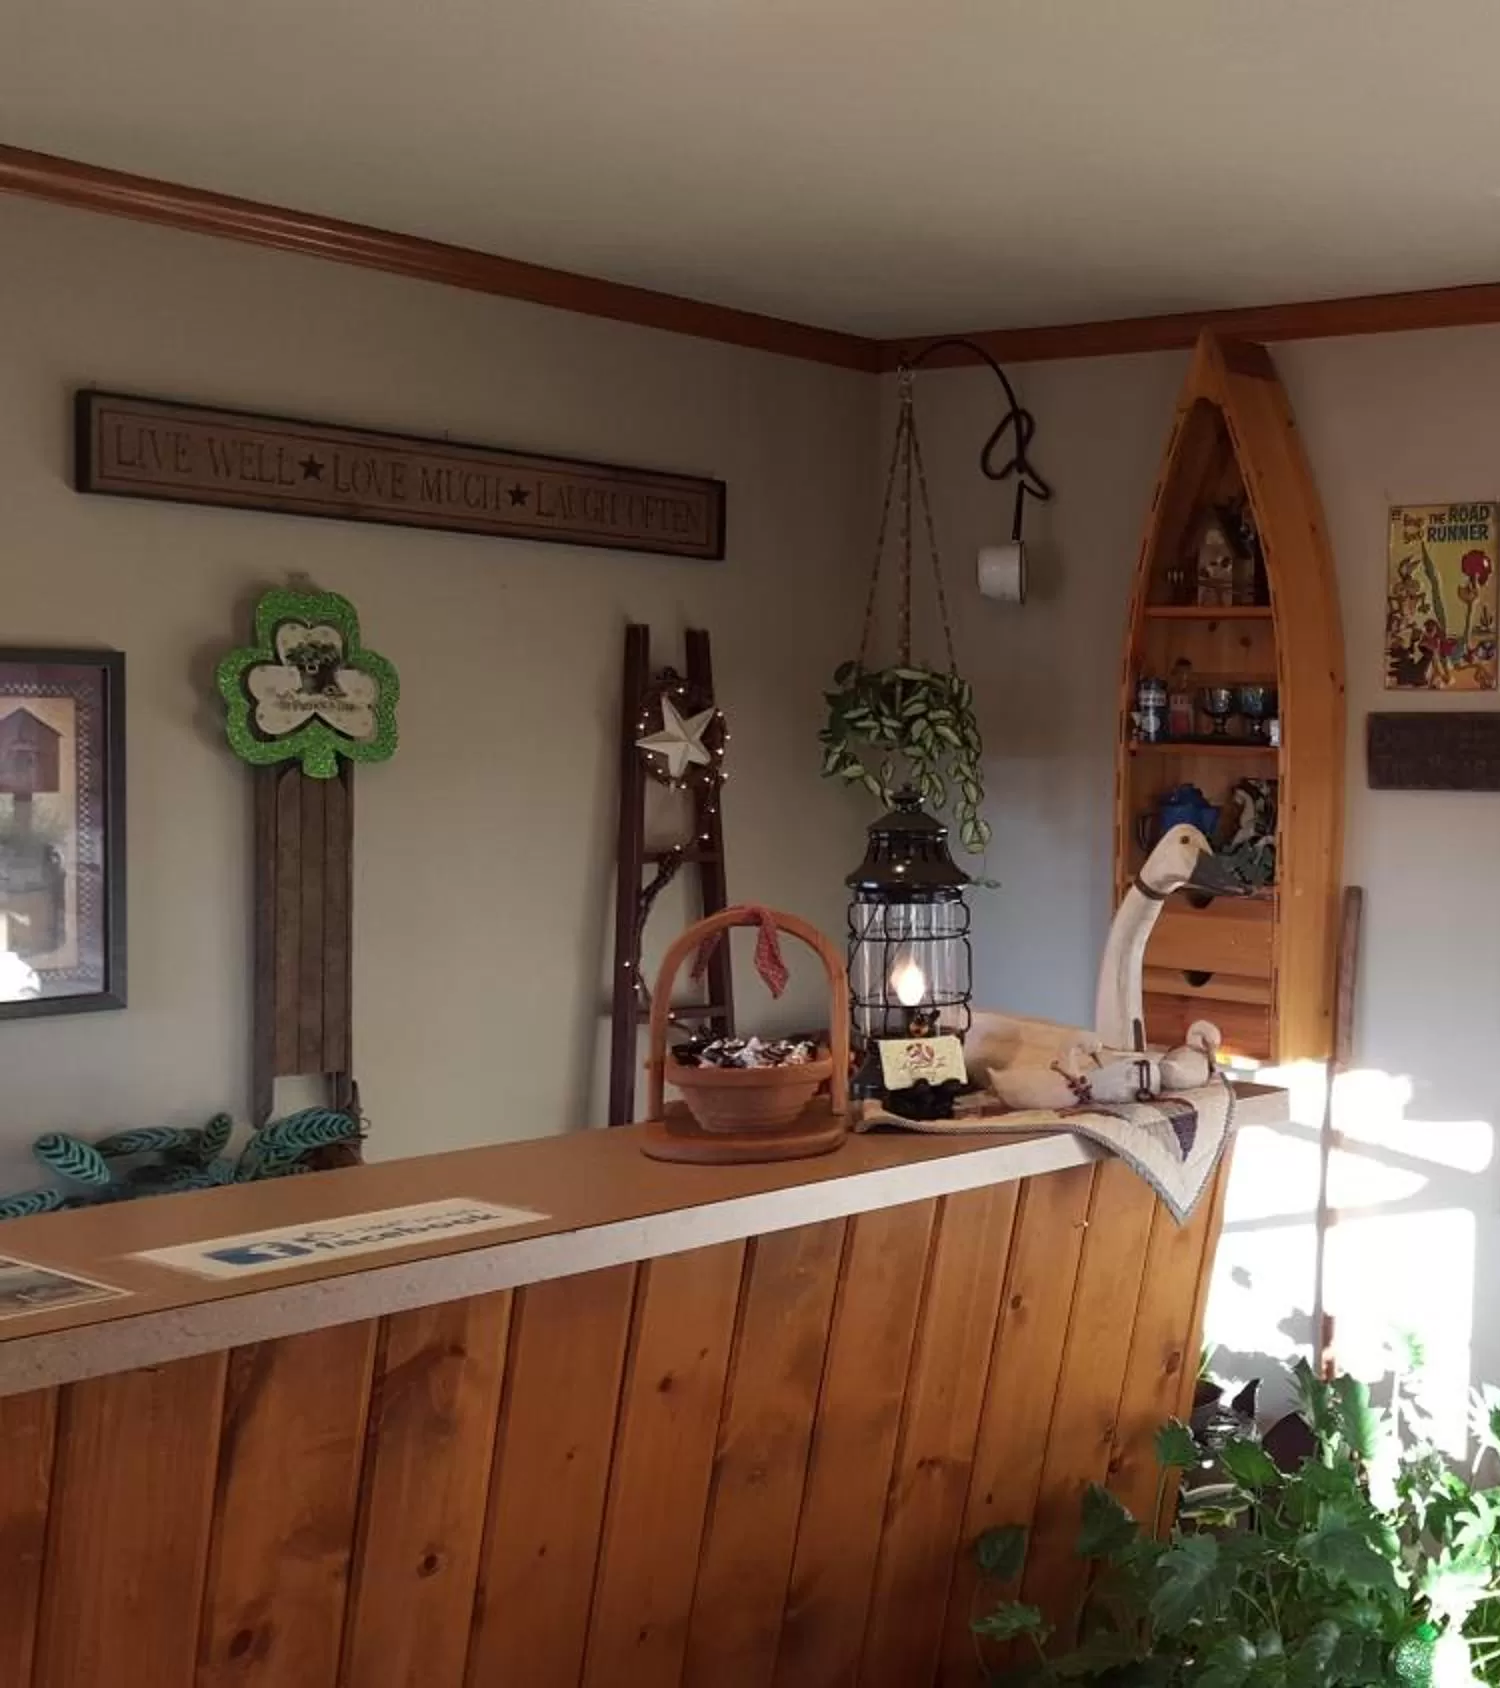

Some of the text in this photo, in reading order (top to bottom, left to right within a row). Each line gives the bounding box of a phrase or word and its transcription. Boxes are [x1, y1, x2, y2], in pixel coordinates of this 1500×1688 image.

[113, 424, 297, 486] LIVE WELL
[331, 452, 502, 511] LOVE MUCH
[534, 481, 699, 537] LAUGH OFTEN
[1426, 523, 1490, 542] RUNNER
[1428, 513, 1447, 525] THE
[1448, 505, 1490, 523] ROAD
